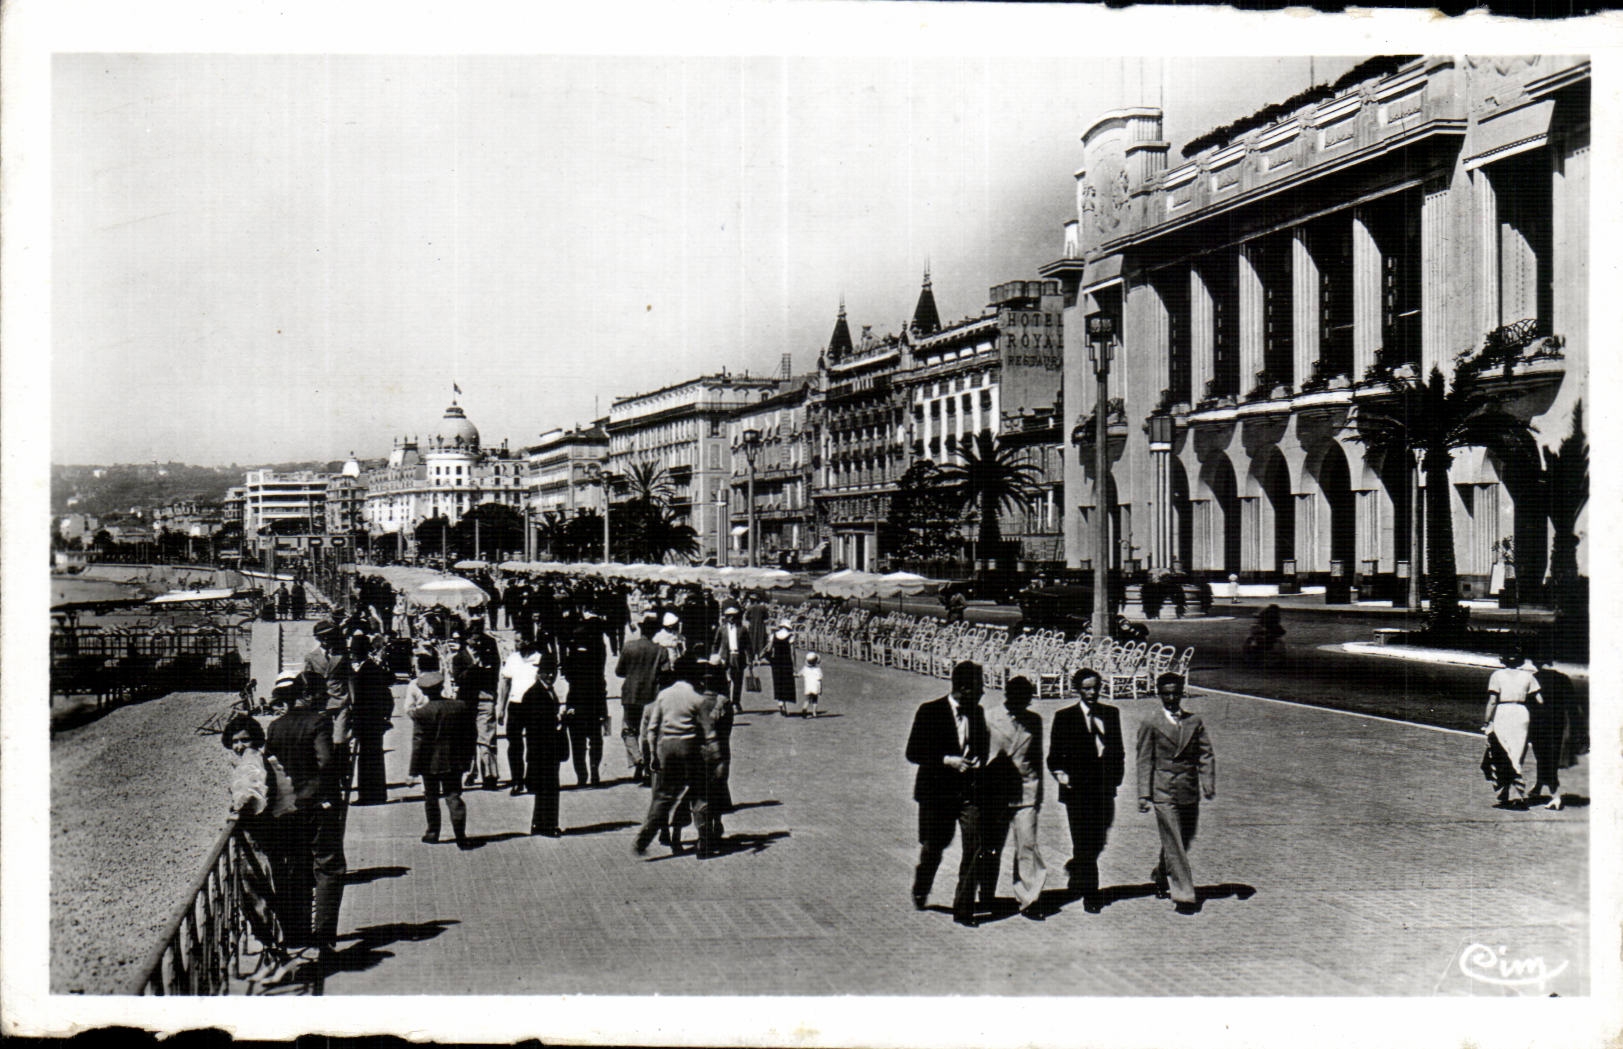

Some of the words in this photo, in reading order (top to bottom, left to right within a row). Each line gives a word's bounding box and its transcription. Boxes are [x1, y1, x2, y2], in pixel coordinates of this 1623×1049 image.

[1007, 312, 1064, 327] HOTEL
[1006, 333, 1064, 348] ROYAL
[275, 536, 347, 549] LIDO
